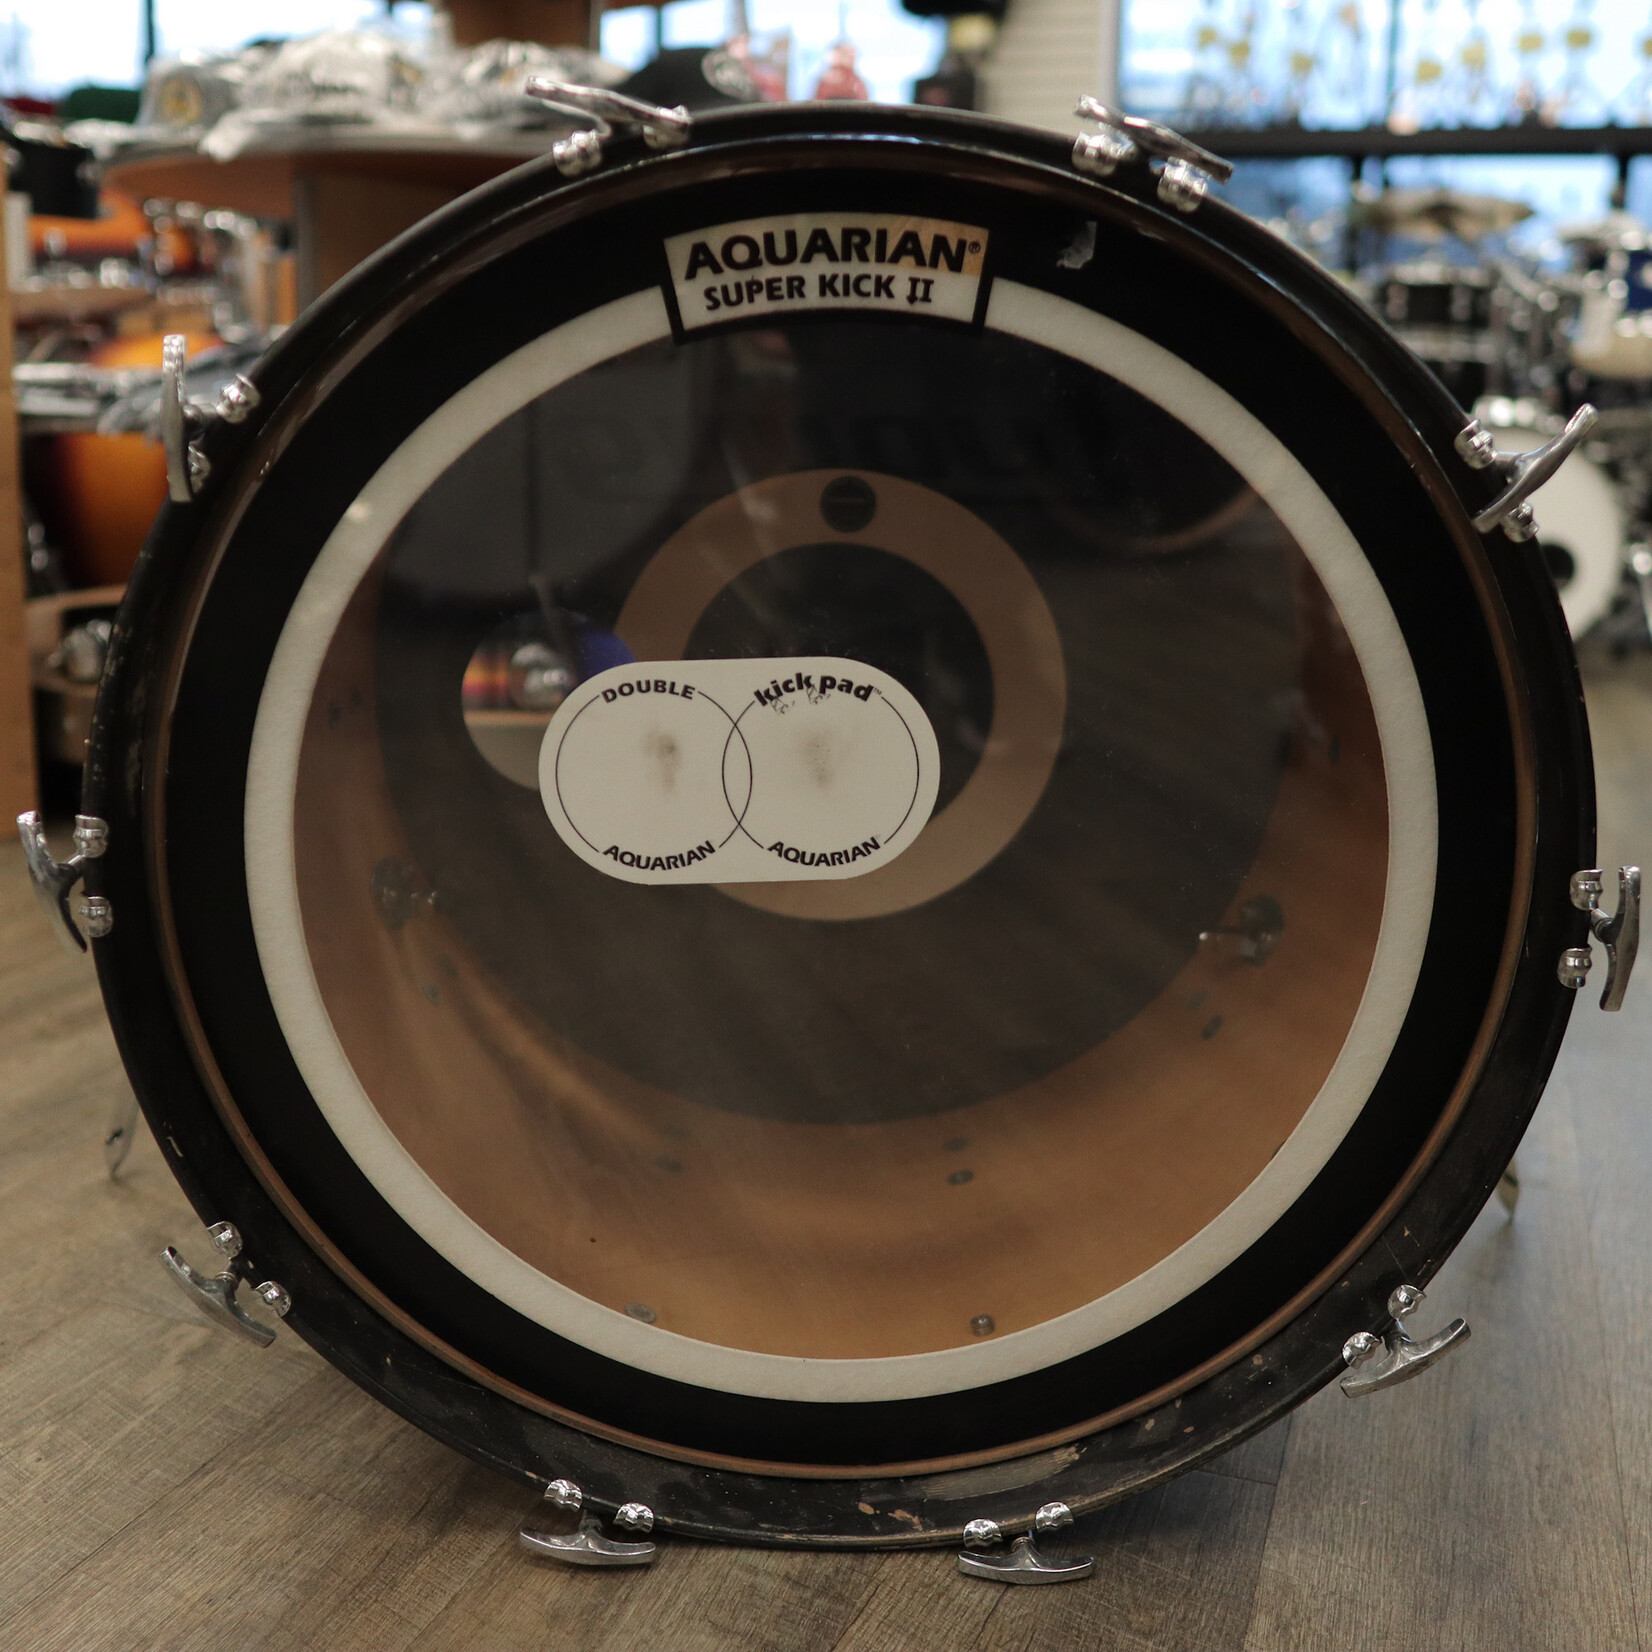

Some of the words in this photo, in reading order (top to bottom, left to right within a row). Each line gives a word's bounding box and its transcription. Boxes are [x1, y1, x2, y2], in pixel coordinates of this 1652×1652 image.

[703, 274, 806, 311] SUPER
[818, 273, 896, 299] KICK
[906, 277, 935, 306] II
[601, 679, 696, 703] DOUBLE
[753, 672, 813, 707] kick
[602, 840, 716, 871] AQUARIAN
[767, 836, 882, 867] AQUARIAN
